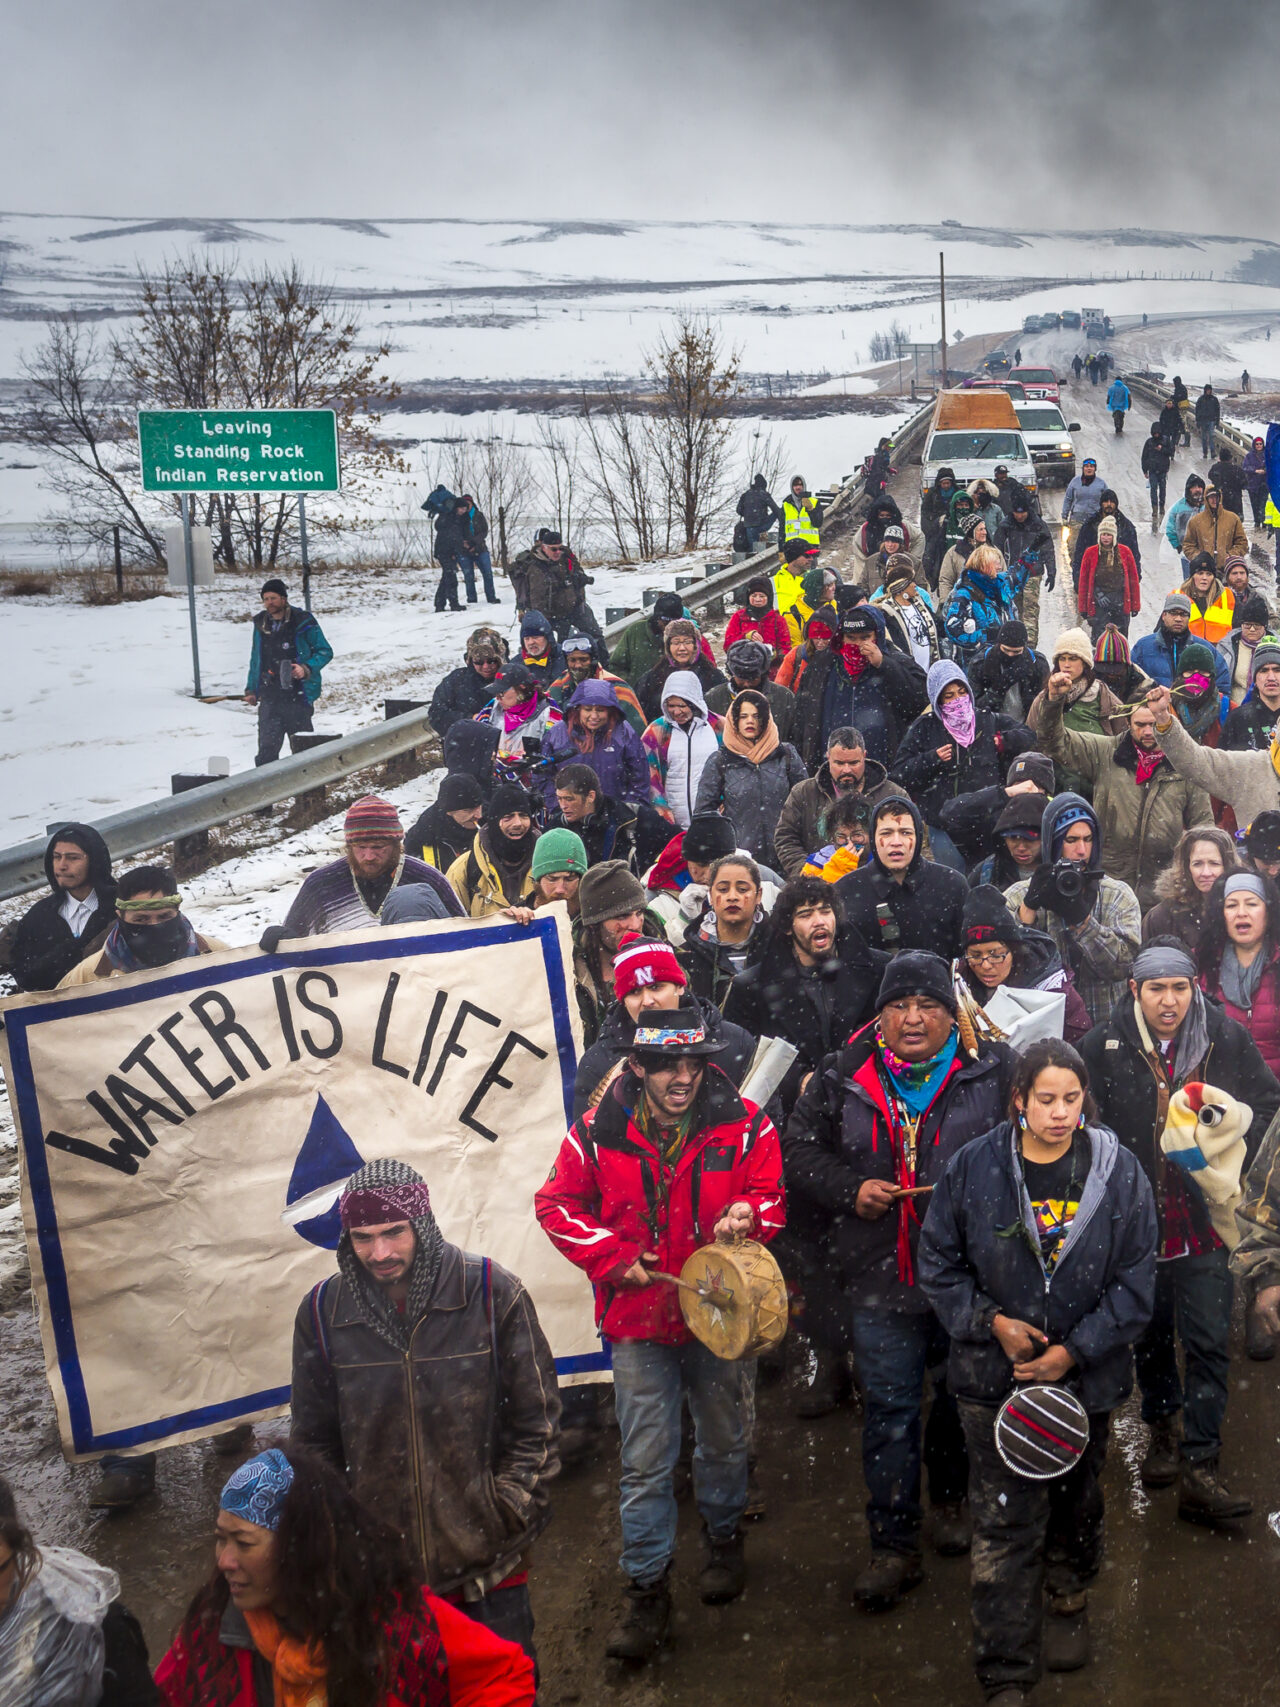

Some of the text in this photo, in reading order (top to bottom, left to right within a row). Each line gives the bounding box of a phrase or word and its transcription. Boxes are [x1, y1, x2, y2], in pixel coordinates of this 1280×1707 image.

[202, 420, 273, 438] Leaving
[174, 444, 305, 462] Standing Rock
[155, 467, 325, 483] Indian Reservation
[634, 965, 655, 986] N
[45, 970, 549, 1176] WATER IS LIFE
